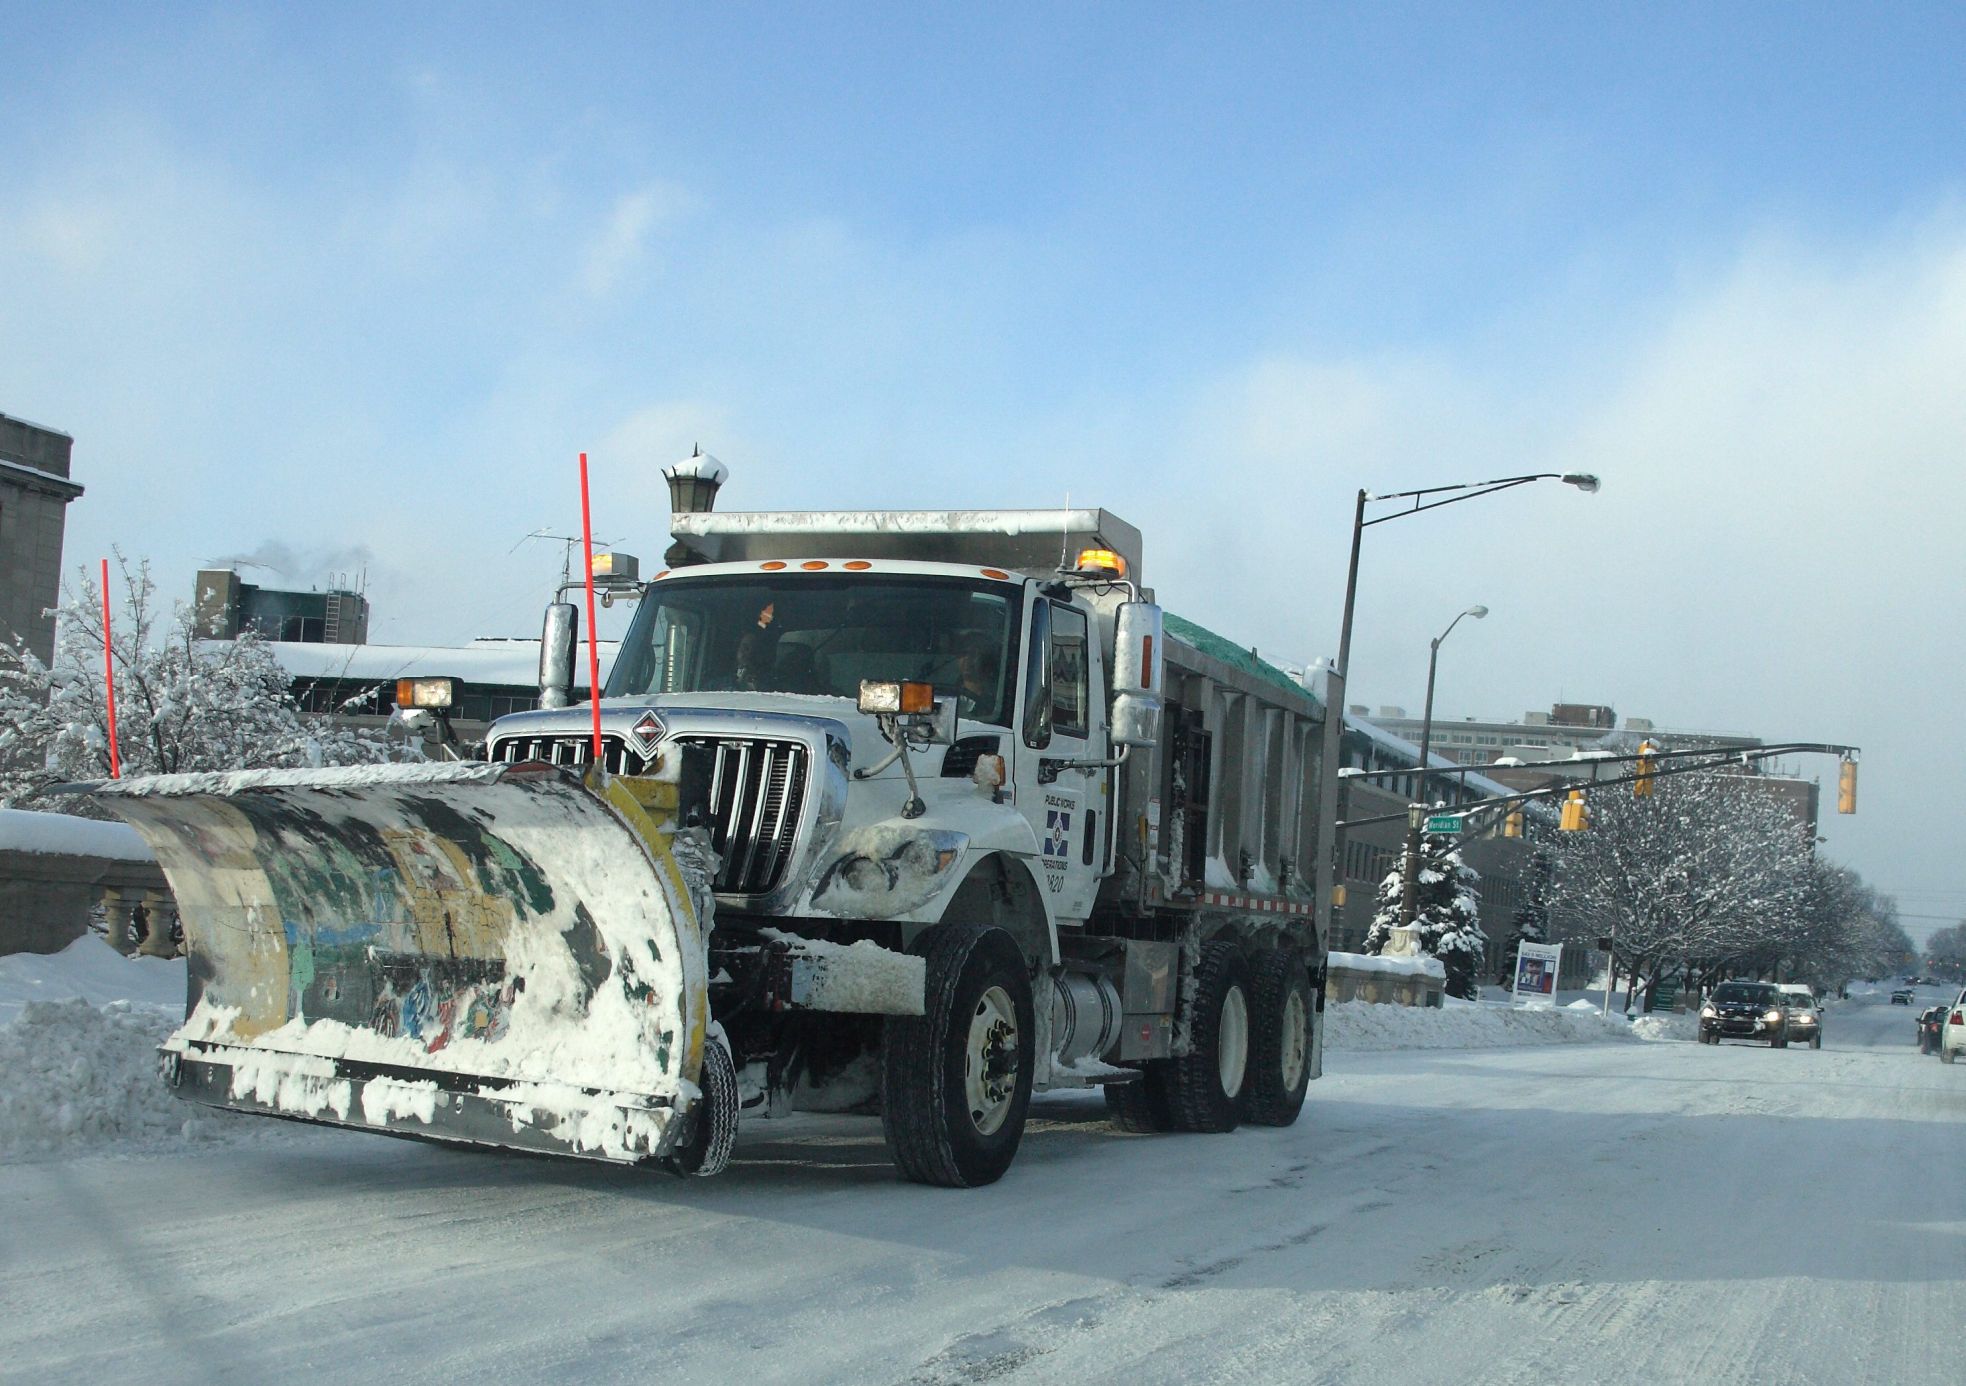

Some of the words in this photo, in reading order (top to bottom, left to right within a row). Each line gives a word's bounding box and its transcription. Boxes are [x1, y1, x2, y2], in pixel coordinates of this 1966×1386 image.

[1045, 794, 1060, 807] PUBLIC
[1060, 798, 1076, 810] WORKS
[1429, 820, 1451, 829] Meridian
[1452, 820, 1460, 829] St
